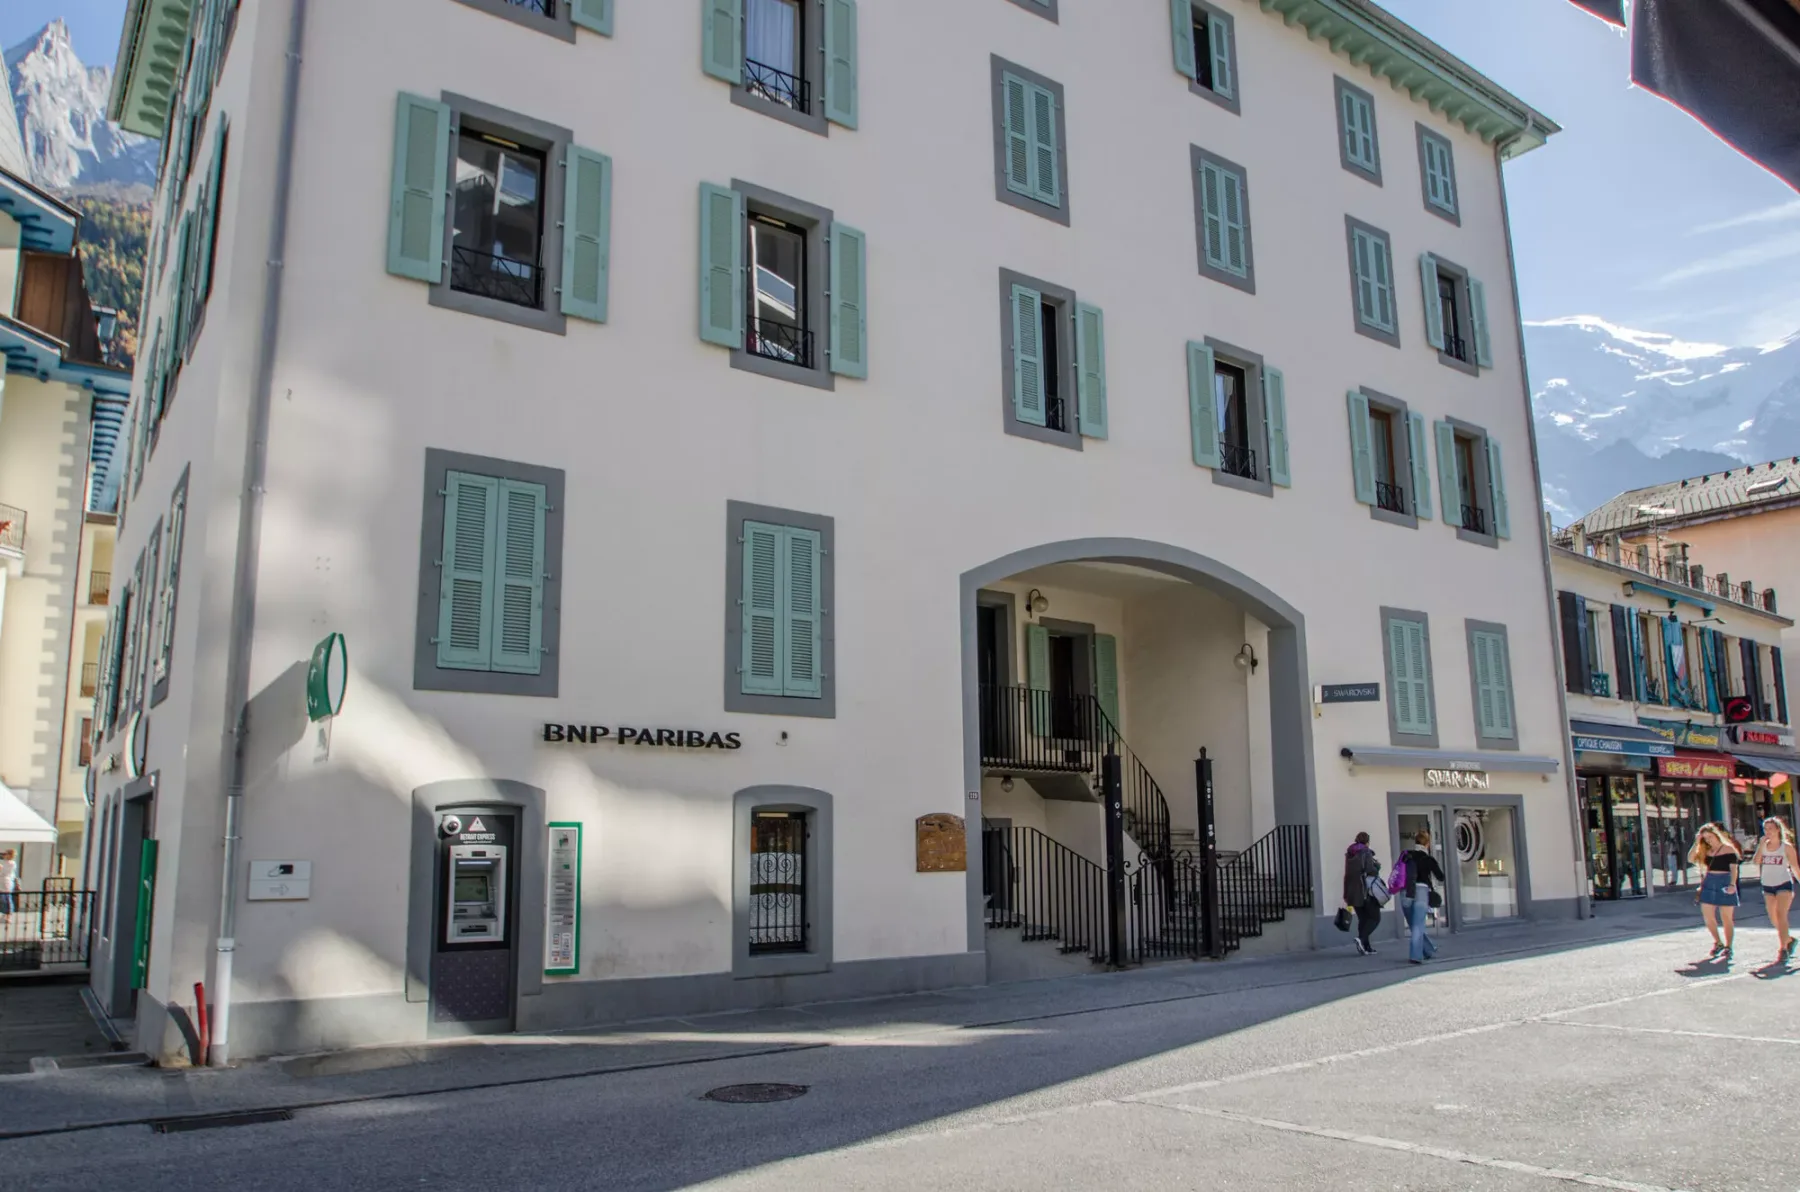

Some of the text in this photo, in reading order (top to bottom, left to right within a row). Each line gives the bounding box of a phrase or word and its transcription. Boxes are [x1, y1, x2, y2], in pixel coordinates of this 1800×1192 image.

[1333, 688, 1375, 698] SWAROVSKI
[543, 723, 742, 749] BNP PARIBAS
